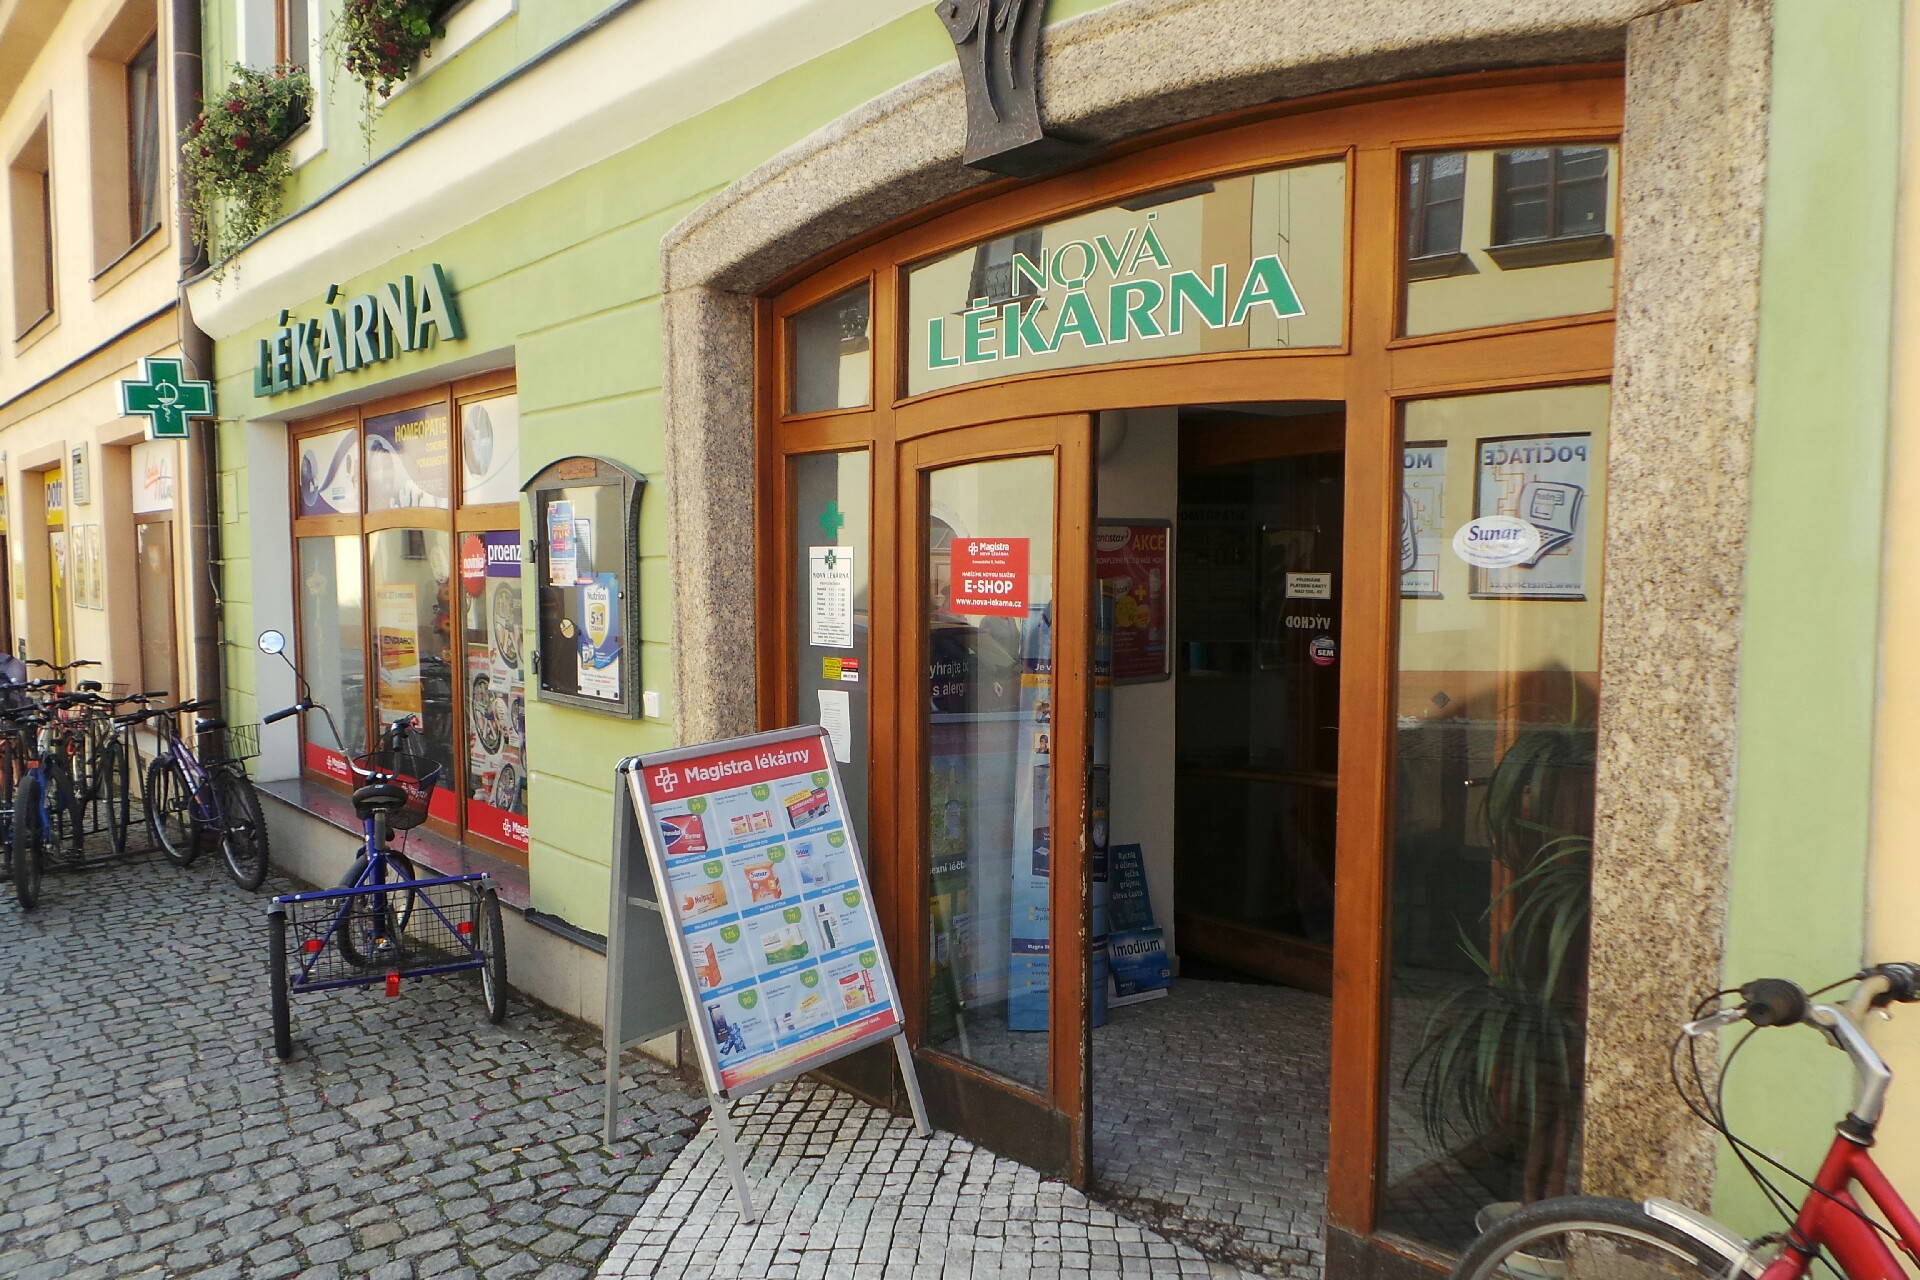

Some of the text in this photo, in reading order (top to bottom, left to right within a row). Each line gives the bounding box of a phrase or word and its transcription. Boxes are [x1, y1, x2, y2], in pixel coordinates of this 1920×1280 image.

[1011, 212, 1173, 297] NOVÁ
[927, 253, 1307, 370] LÉKÁRNA
[253, 263, 464, 398] LÉKÁRNA
[394, 416, 448, 443] HOMEOPATIE
[1468, 525, 1521, 541] Sunar
[979, 542, 1010, 552] Magistra
[1132, 534, 1165, 550] AKCE
[964, 579, 1013, 594] E-SHOP
[590, 611, 604, 625] 5+1
[1035, 663, 1045, 671] Je
[932, 684, 940, 696] s
[684, 748, 810, 784] Magistra lékárny
[750, 870, 768, 879] Sunar
[1113, 939, 1160, 957] Imodium
